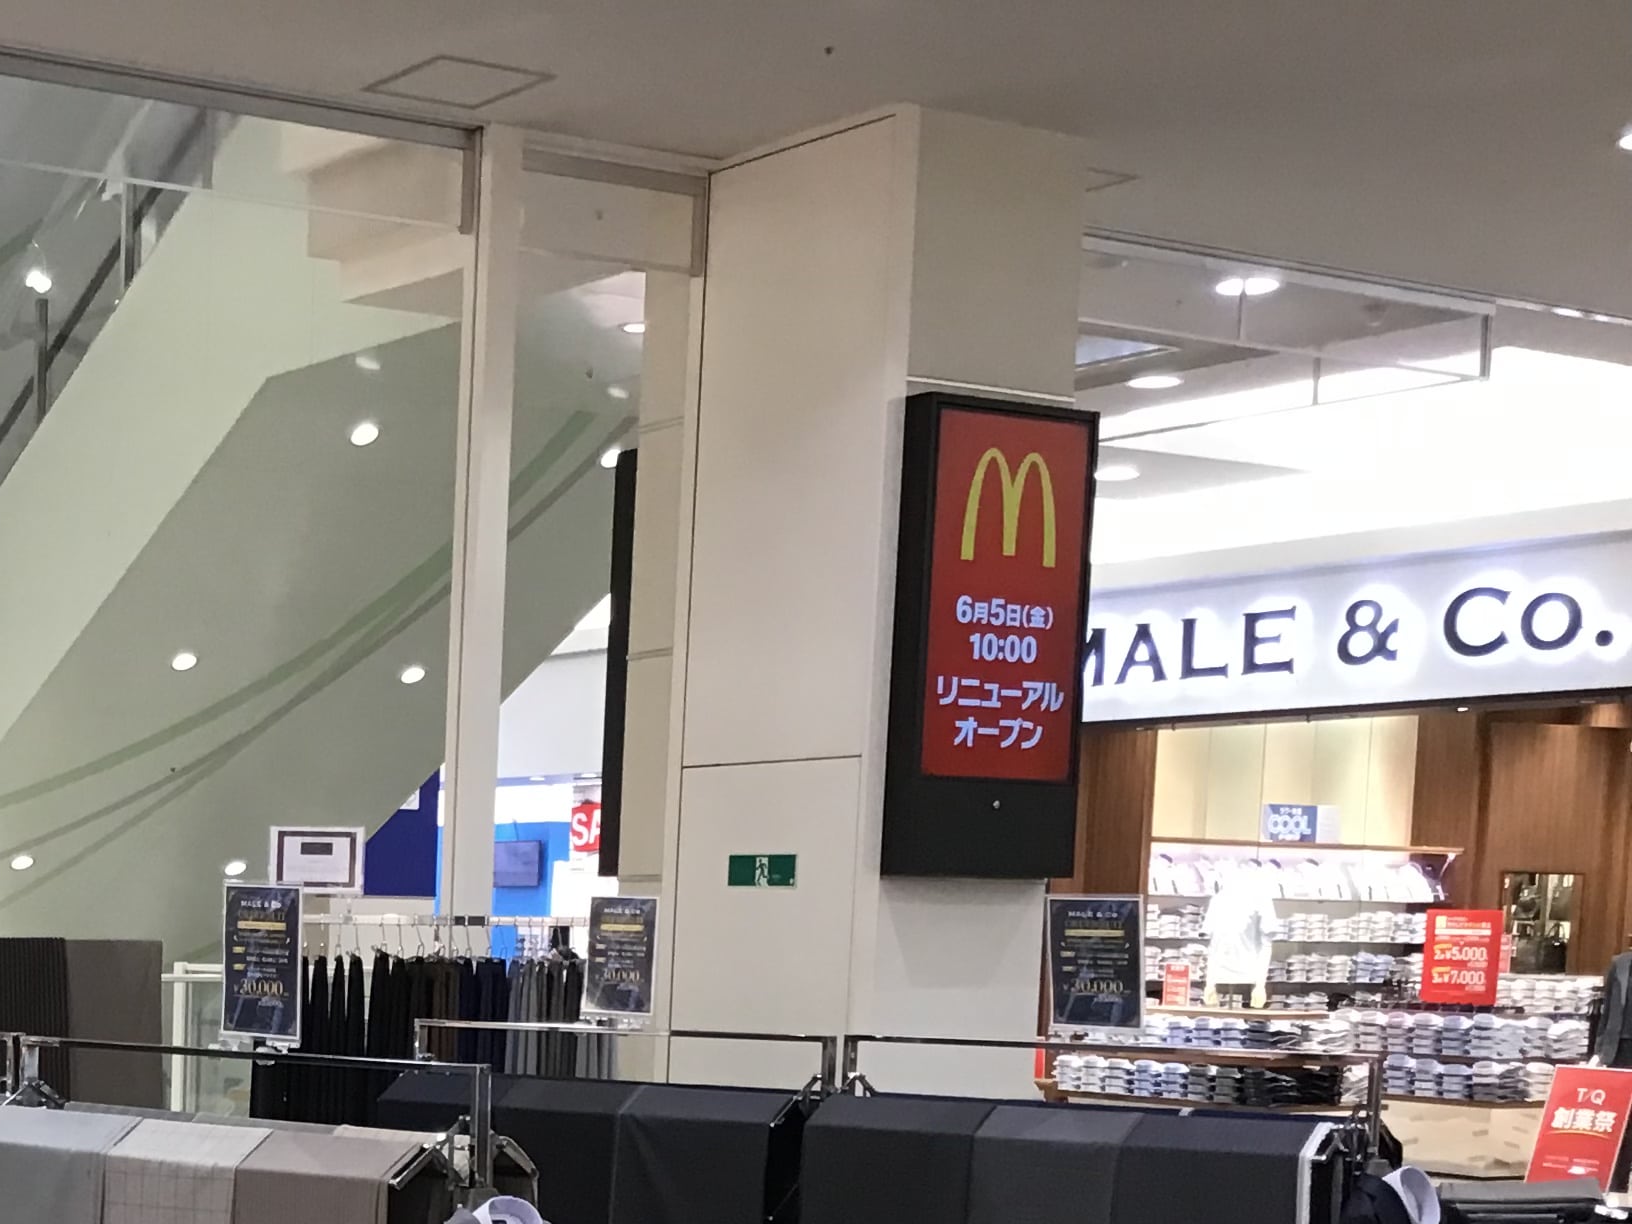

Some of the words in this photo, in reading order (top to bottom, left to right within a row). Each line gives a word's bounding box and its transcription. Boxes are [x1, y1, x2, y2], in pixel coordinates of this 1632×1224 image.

[956, 595, 1054, 630] 6月5日(金)
[969, 632, 1038, 664] 10:00
[1336, 599, 1399, 666] &
[936, 675, 1065, 712] リニューアル
[953, 716, 1043, 750] オープン
